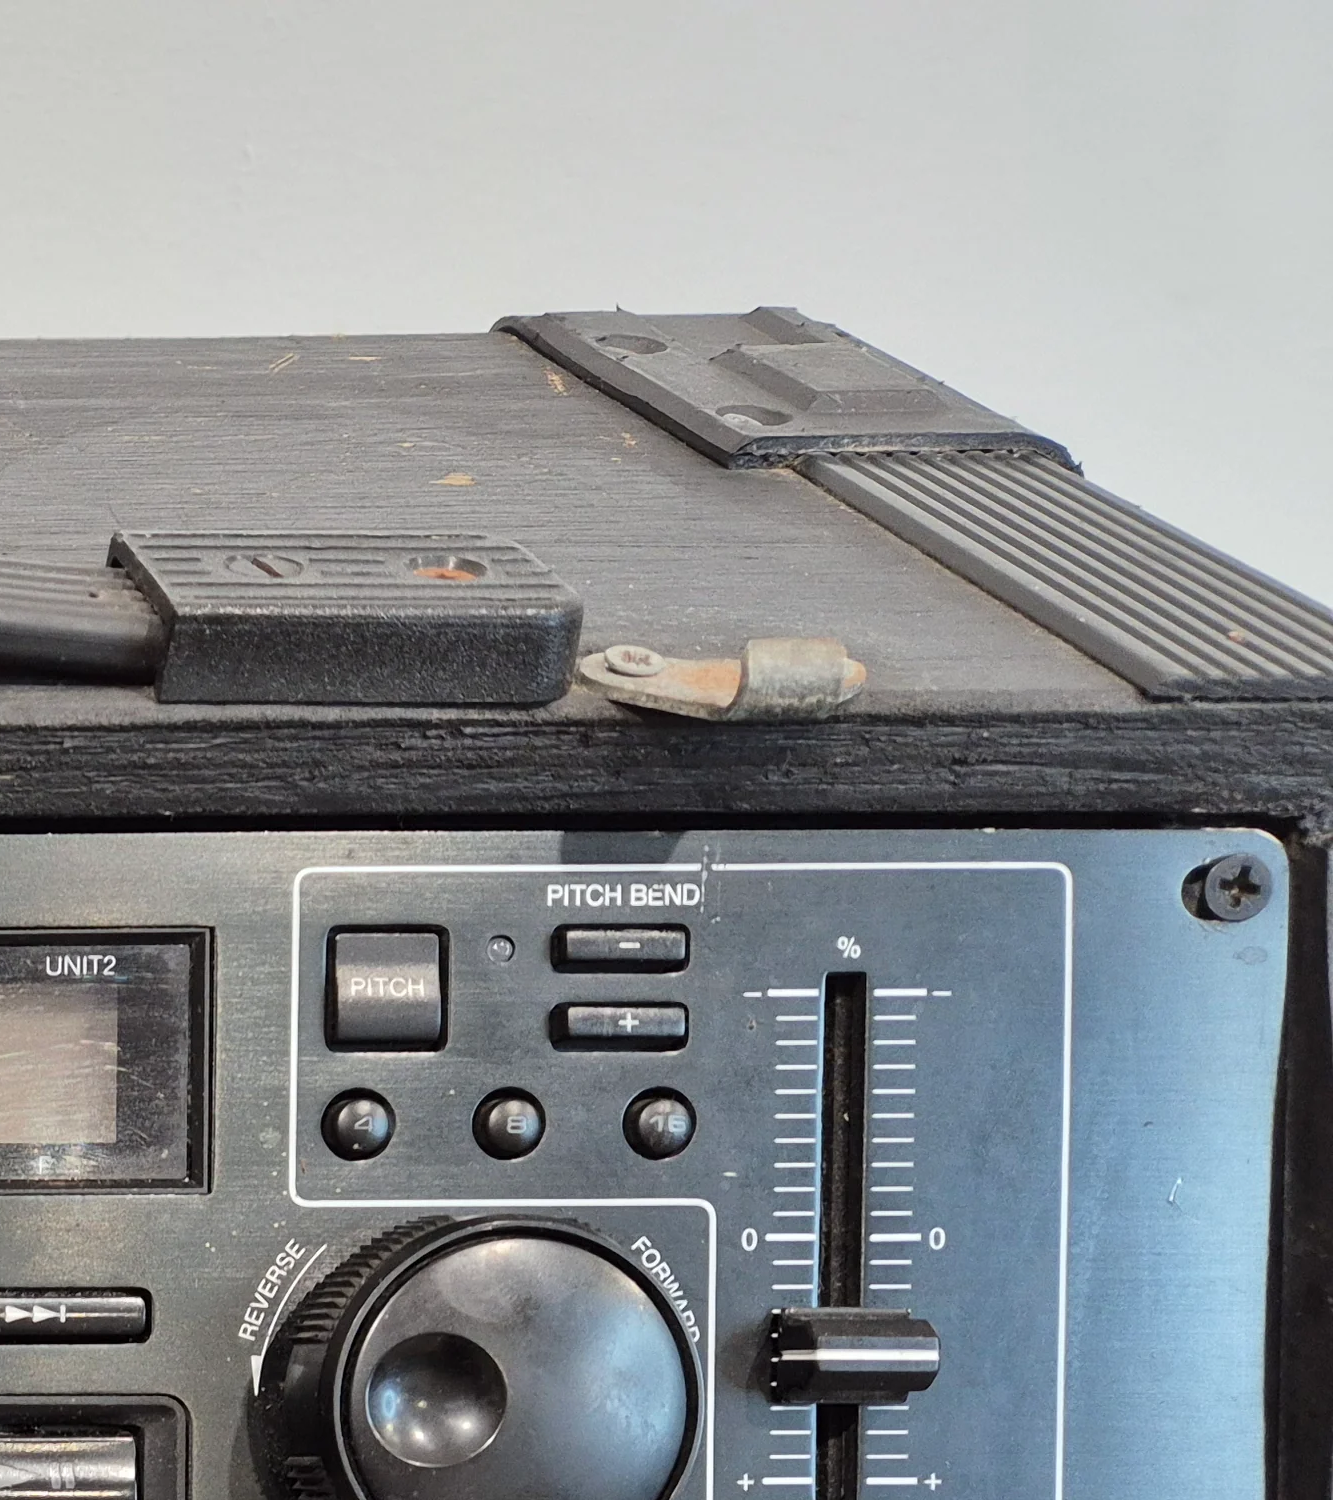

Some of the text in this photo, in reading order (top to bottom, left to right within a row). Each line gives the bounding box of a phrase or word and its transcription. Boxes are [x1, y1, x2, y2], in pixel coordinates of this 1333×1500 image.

[546, 883, 701, 907] PITCH BEND
[45, 954, 117, 978] UNIT2
[350, 977, 425, 998] PITCH
[354, 1115, 374, 1133] 4
[507, 1115, 527, 1133] 8
[650, 1114, 686, 1134] 16
[239, 1238, 305, 1342] REVERSE
